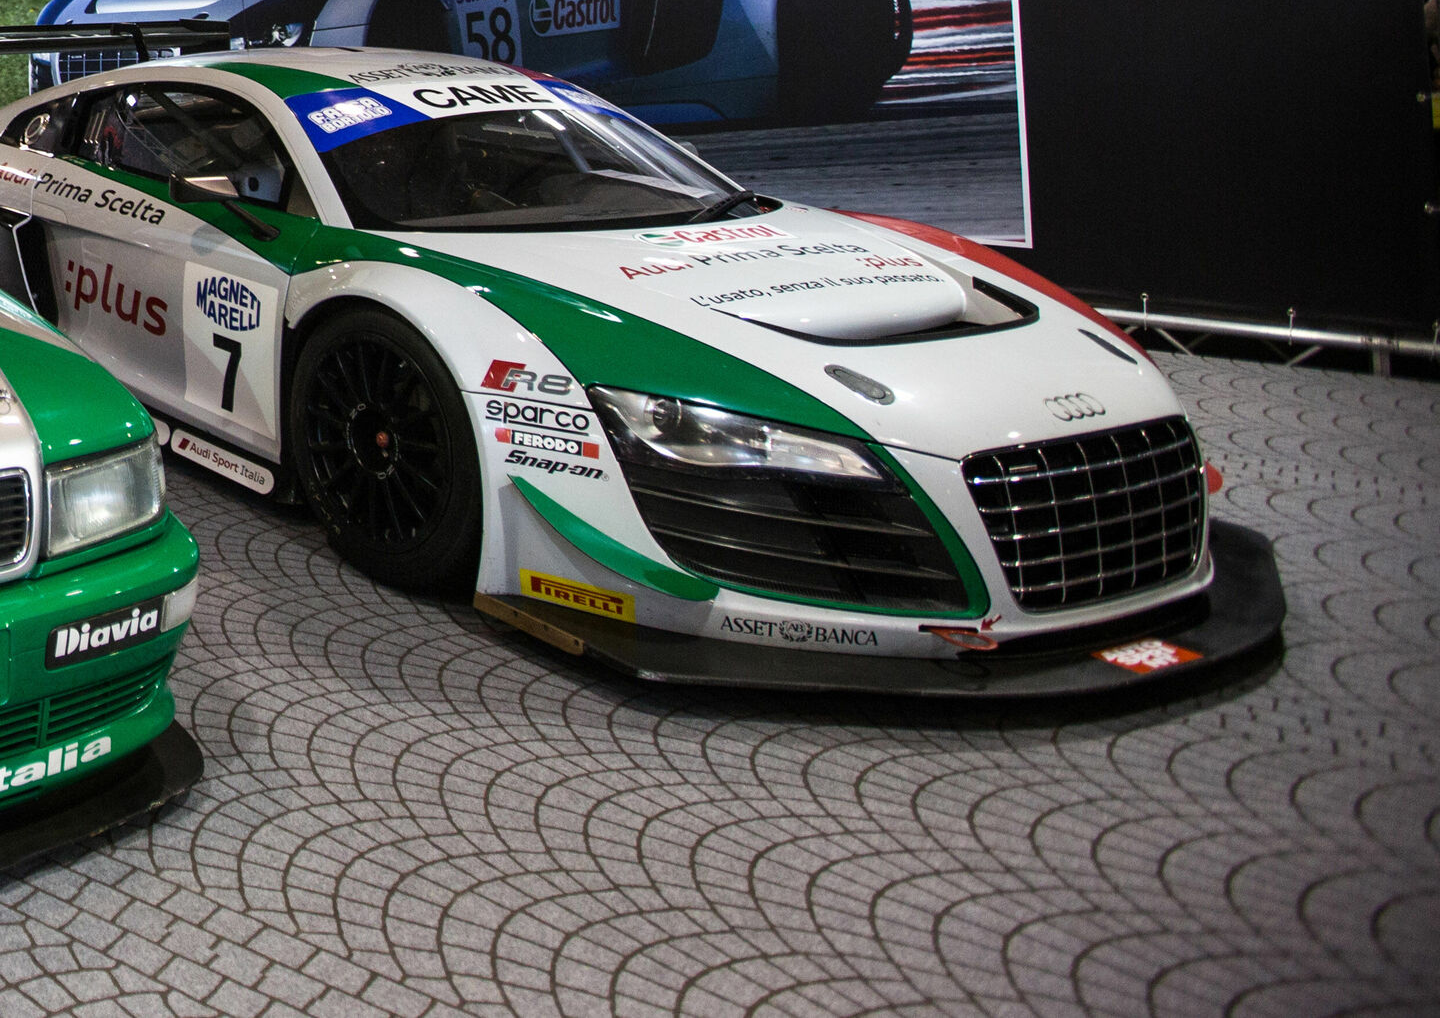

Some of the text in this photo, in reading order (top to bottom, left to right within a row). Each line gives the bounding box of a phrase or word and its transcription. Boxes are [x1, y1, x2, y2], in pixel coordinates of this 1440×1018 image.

[465, 6, 517, 64] 58
[413, 85, 554, 109] CAME
[34, 172, 93, 204] Prima
[94, 188, 167, 226] Scelta
[673, 224, 790, 244] Castrol
[688, 248, 783, 266] Prima
[776, 242, 870, 256] Scelta
[856, 254, 924, 270] :plus
[64, 259, 170, 337] :plus
[196, 276, 261, 312] MAGNETI
[771, 280, 824, 294] senza
[820, 277, 841, 286] il
[839, 274, 874, 286] suo
[196, 296, 261, 332] MARELLI
[212, 332, 242, 413] 7
[500, 368, 574, 396] R8
[485, 399, 590, 432] sparco
[513, 433, 580, 454] FERODO
[190, 443, 266, 486] Audi Sport Italia
[505, 450, 605, 480] Snap-on
[530, 575, 624, 615] PIRELLI
[54, 607, 160, 658] Diavia
[720, 615, 778, 638] ASSET
[814, 626, 879, 646] BANCA
